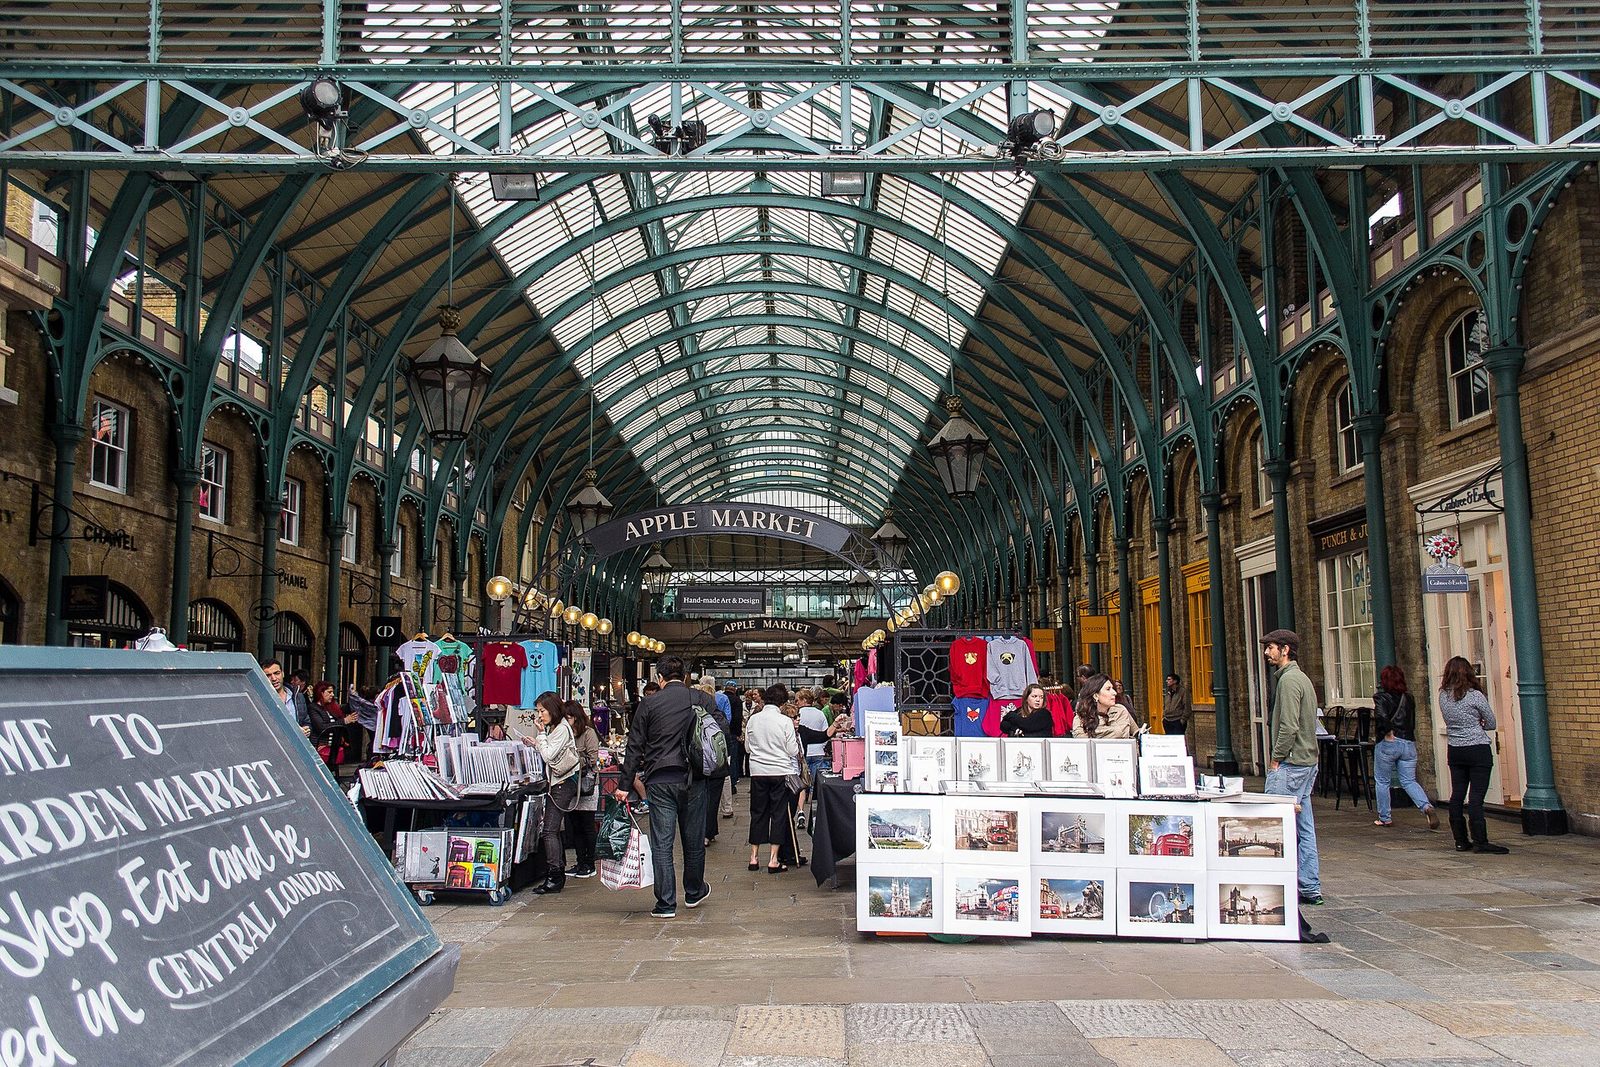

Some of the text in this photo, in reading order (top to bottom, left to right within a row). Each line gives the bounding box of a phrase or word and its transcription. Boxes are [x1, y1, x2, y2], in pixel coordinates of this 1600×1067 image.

[83, 525, 138, 552] CHANEL
[625, 509, 820, 541] APPLE MARKET
[1320, 530, 1348, 550] PUNCH
[1349, 527, 1358, 541] &
[279, 571, 308, 590] CHANEL
[683, 596, 720, 604] Hand-made
[721, 596, 731, 604] Art
[738, 596, 760, 605] Design
[723, 619, 811, 634] APPLE MARKET
[0, 712, 164, 776] ME TO
[136, 760, 285, 827] MARKET
[208, 824, 276, 891] and
[260, 816, 311, 864] be
[71, 978, 146, 1037] in
[148, 900, 276, 1000] CENTRAL
[269, 870, 346, 920] LONDON
